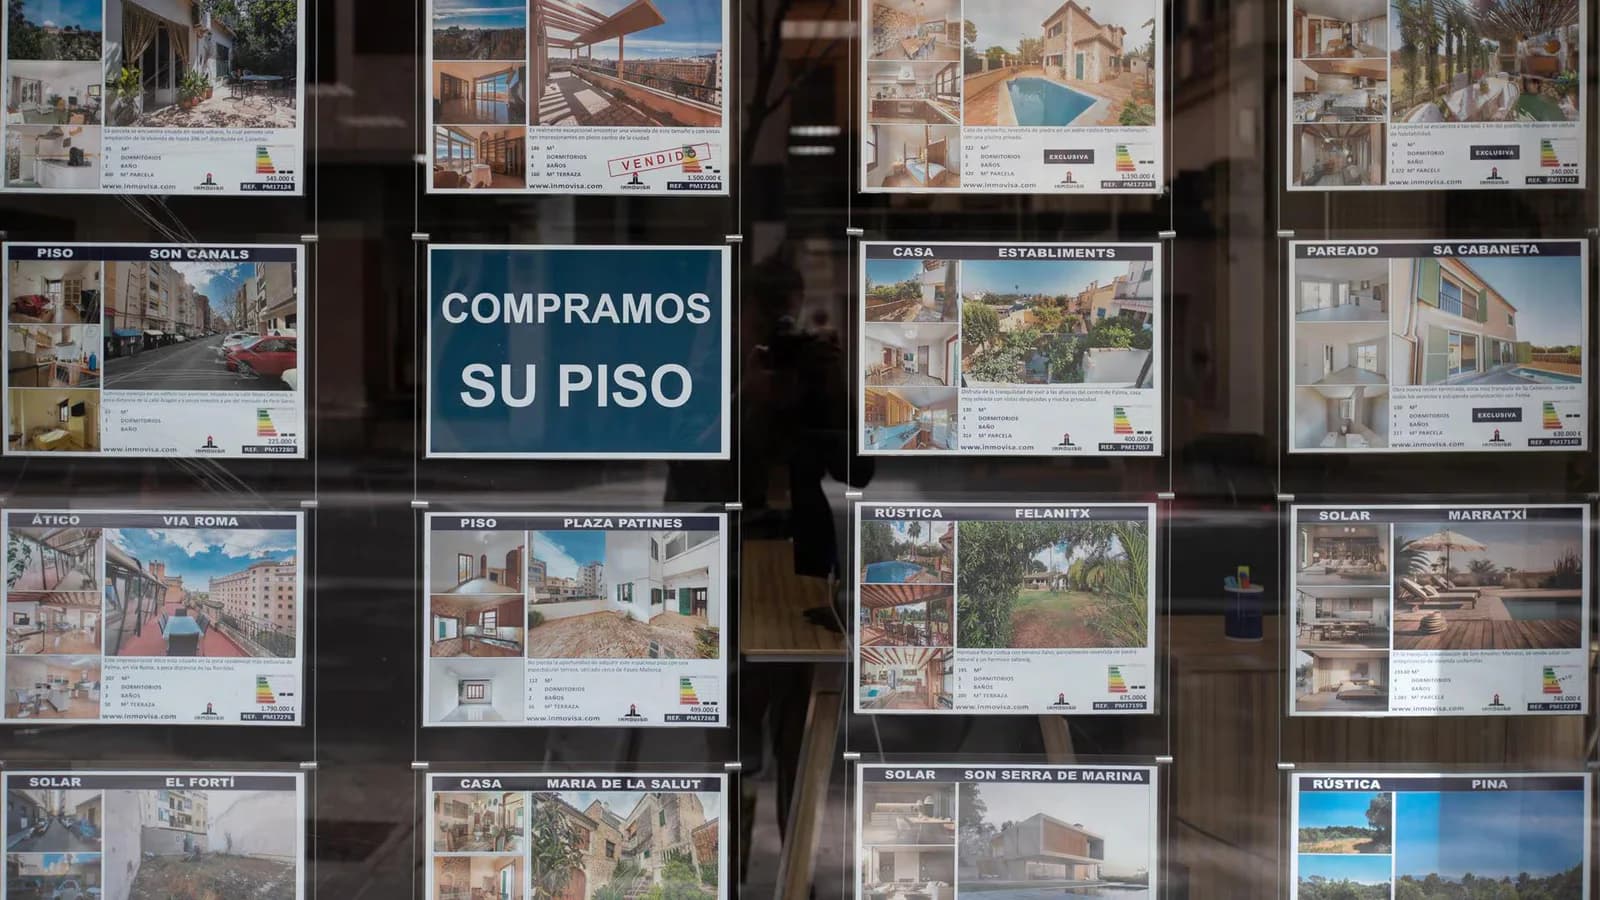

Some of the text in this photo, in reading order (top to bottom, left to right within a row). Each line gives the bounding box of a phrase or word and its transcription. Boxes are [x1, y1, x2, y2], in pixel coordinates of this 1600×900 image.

[621, 146, 697, 171] VENDIDO
[102, 183, 176, 191] www.inmovisa.com
[37, 248, 73, 258] PISO
[150, 249, 249, 260] SON CANALS
[893, 247, 934, 257] CASA
[998, 248, 1116, 258] ESTABLIMENTS
[1307, 246, 1379, 256] PAREADO
[1433, 244, 1540, 255] SA CABANETA
[442, 292, 711, 324] COMPRAMOS
[460, 363, 693, 408] SU PISO
[875, 507, 942, 518] RÚSTICA
[1016, 508, 1090, 518] FELANITX
[1319, 511, 1370, 521] SOLAR
[1448, 508, 1527, 520] MARRATXÍ
[32, 514, 80, 524] ÁTICO
[163, 516, 238, 526] VIA ROMA
[460, 518, 496, 528] PISO
[564, 518, 682, 528] PLAZA PATINES
[884, 770, 936, 780] SOLAR
[964, 770, 1143, 781] SON SERRA DE MARINA
[30, 778, 81, 786] SOLAR
[166, 776, 234, 787] EL FORTÍ
[460, 779, 502, 788] CASA
[547, 779, 700, 789] MARIA DE LA SALUT
[1313, 778, 1380, 789] RÚSTICA
[1472, 780, 1508, 789] PINA
